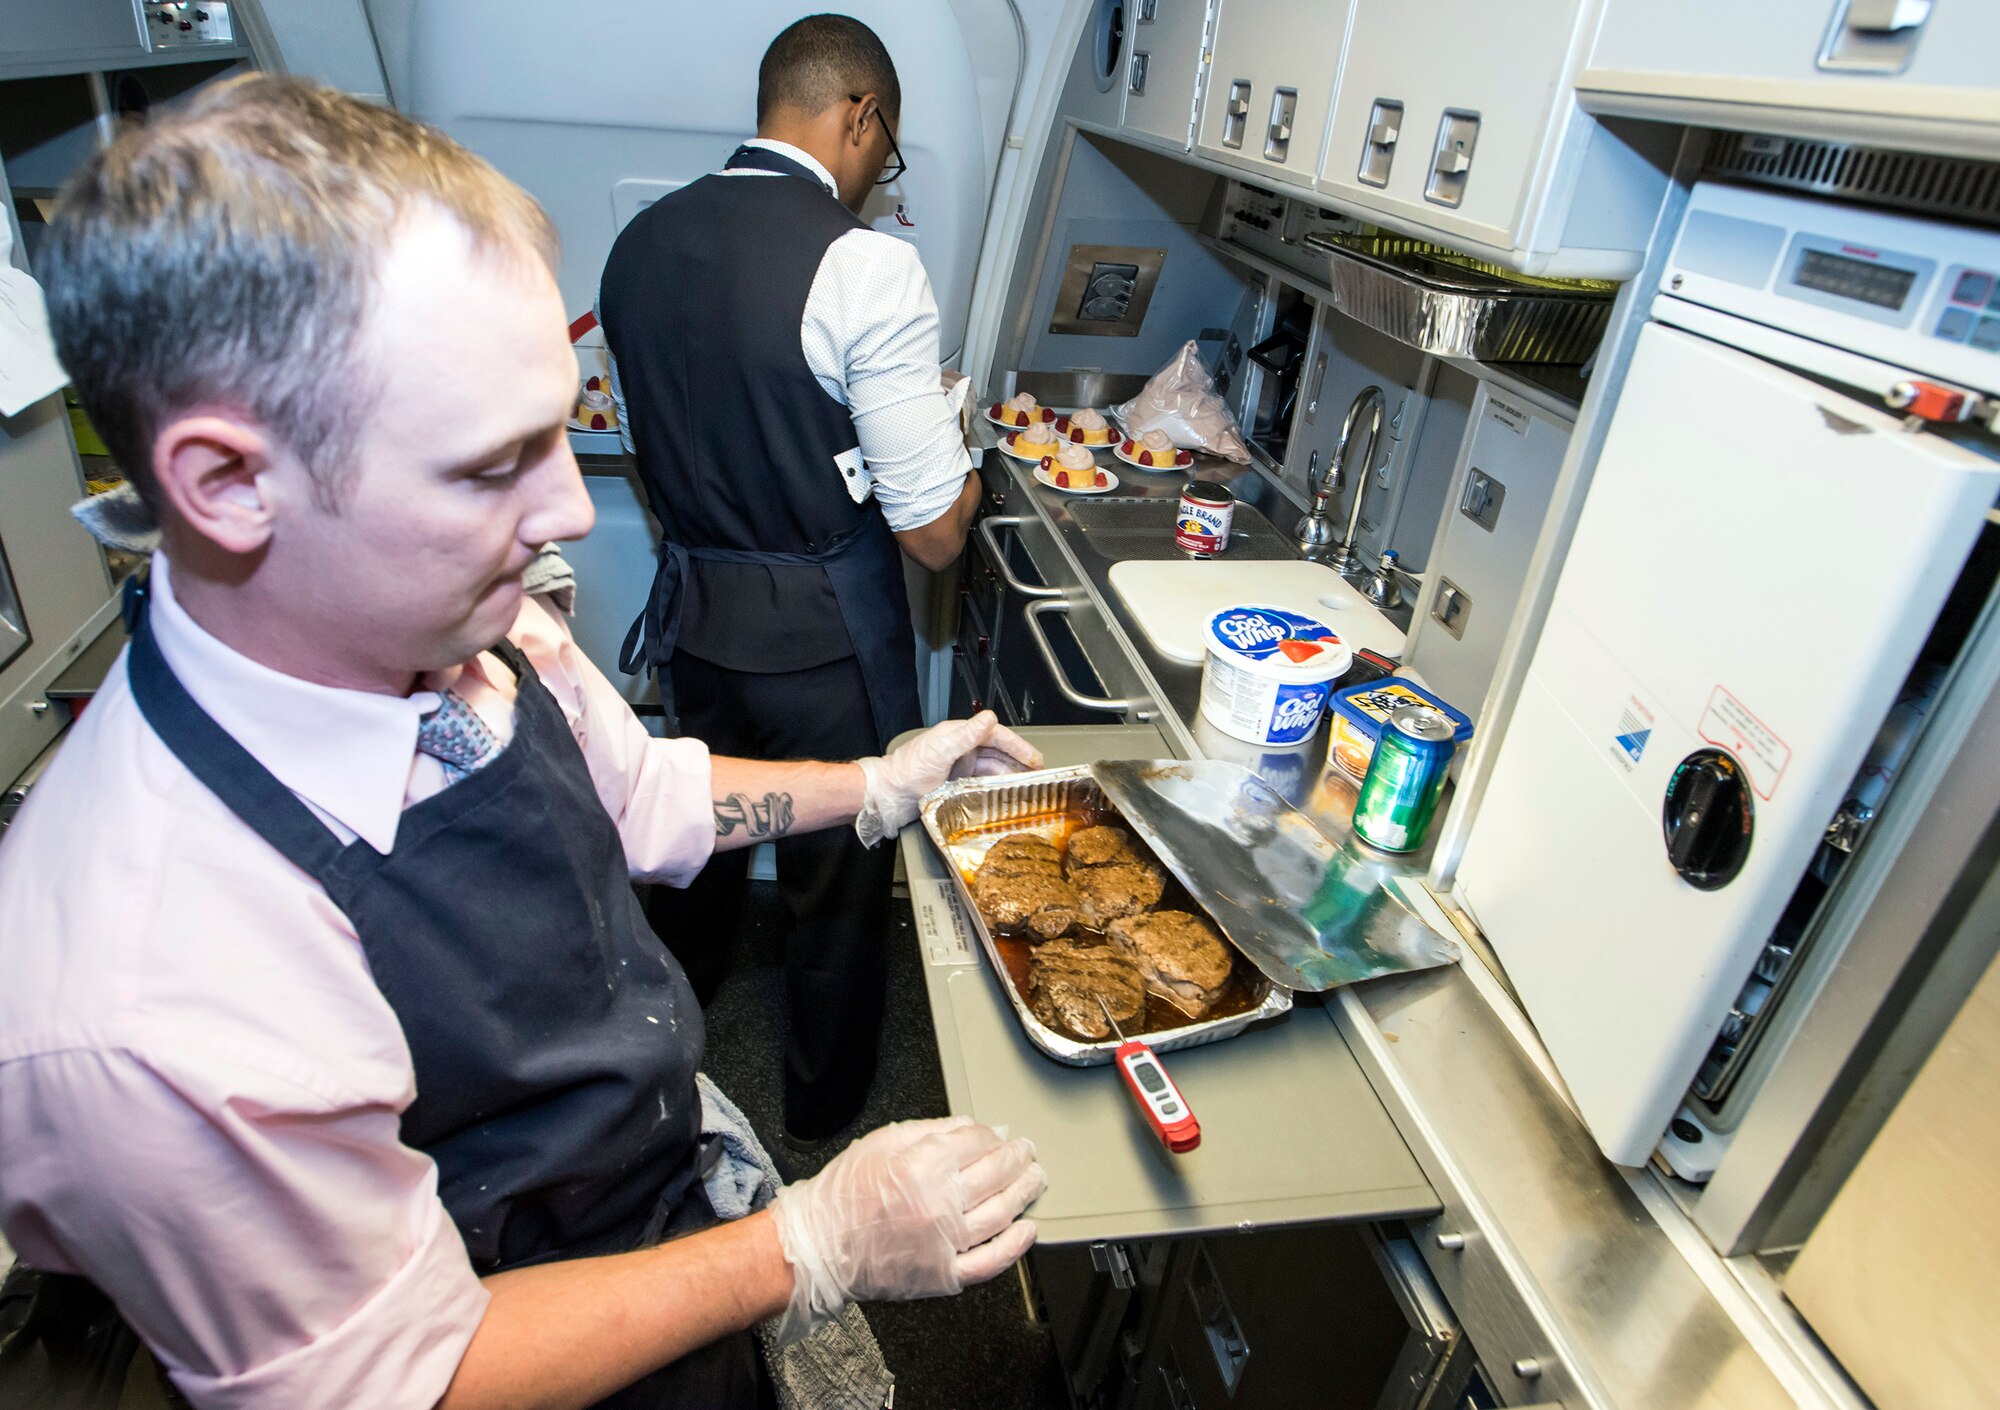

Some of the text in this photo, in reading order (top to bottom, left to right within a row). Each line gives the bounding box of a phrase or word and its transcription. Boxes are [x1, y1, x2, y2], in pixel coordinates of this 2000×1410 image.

[1195, 508, 1222, 529] BRAND
[1219, 614, 1271, 636] Cool
[1293, 622, 1323, 632] Original
[1228, 625, 1286, 649] Whip
[1279, 693, 1324, 717] Cool
[1271, 709, 1319, 732] Whip
